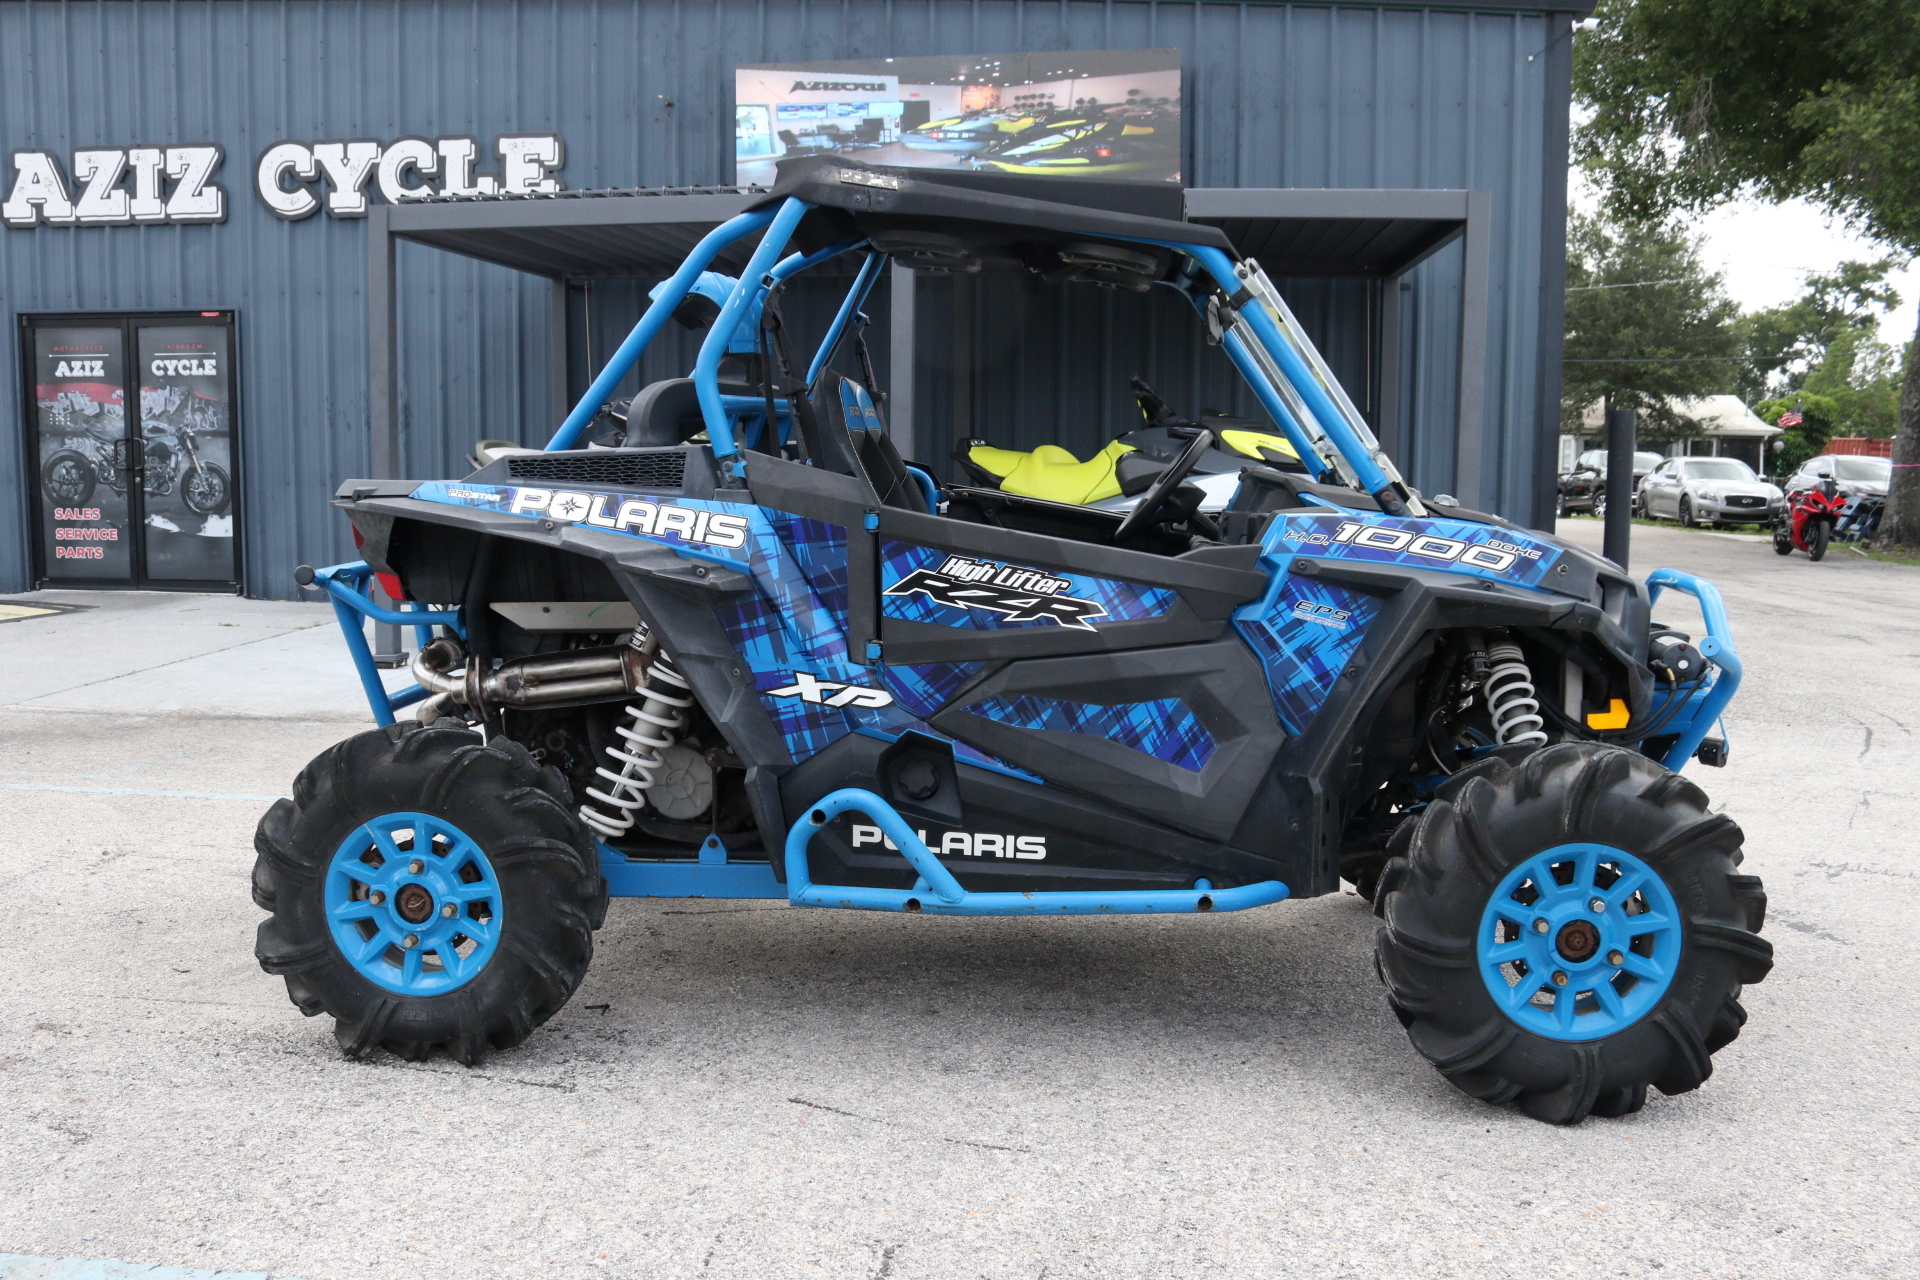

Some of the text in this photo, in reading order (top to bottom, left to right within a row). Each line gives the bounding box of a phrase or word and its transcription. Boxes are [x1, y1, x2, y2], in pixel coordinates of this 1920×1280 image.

[3, 134, 562, 221] AZIZ CYCLE
[54, 360, 105, 377] AZIZ
[151, 359, 217, 376] CYCLE
[448, 489, 501, 502] PROSTAR
[55, 508, 101, 520] SALES
[509, 487, 749, 549] POLARIS
[55, 528, 118, 541] SERVICE
[56, 547, 104, 559] PARTS
[1283, 521, 1543, 573] H.O. 1000 DOHC
[941, 557, 1071, 595] High Lifter
[883, 569, 1109, 632] RZR
[1295, 600, 1351, 622] EPS
[767, 672, 894, 708] XP
